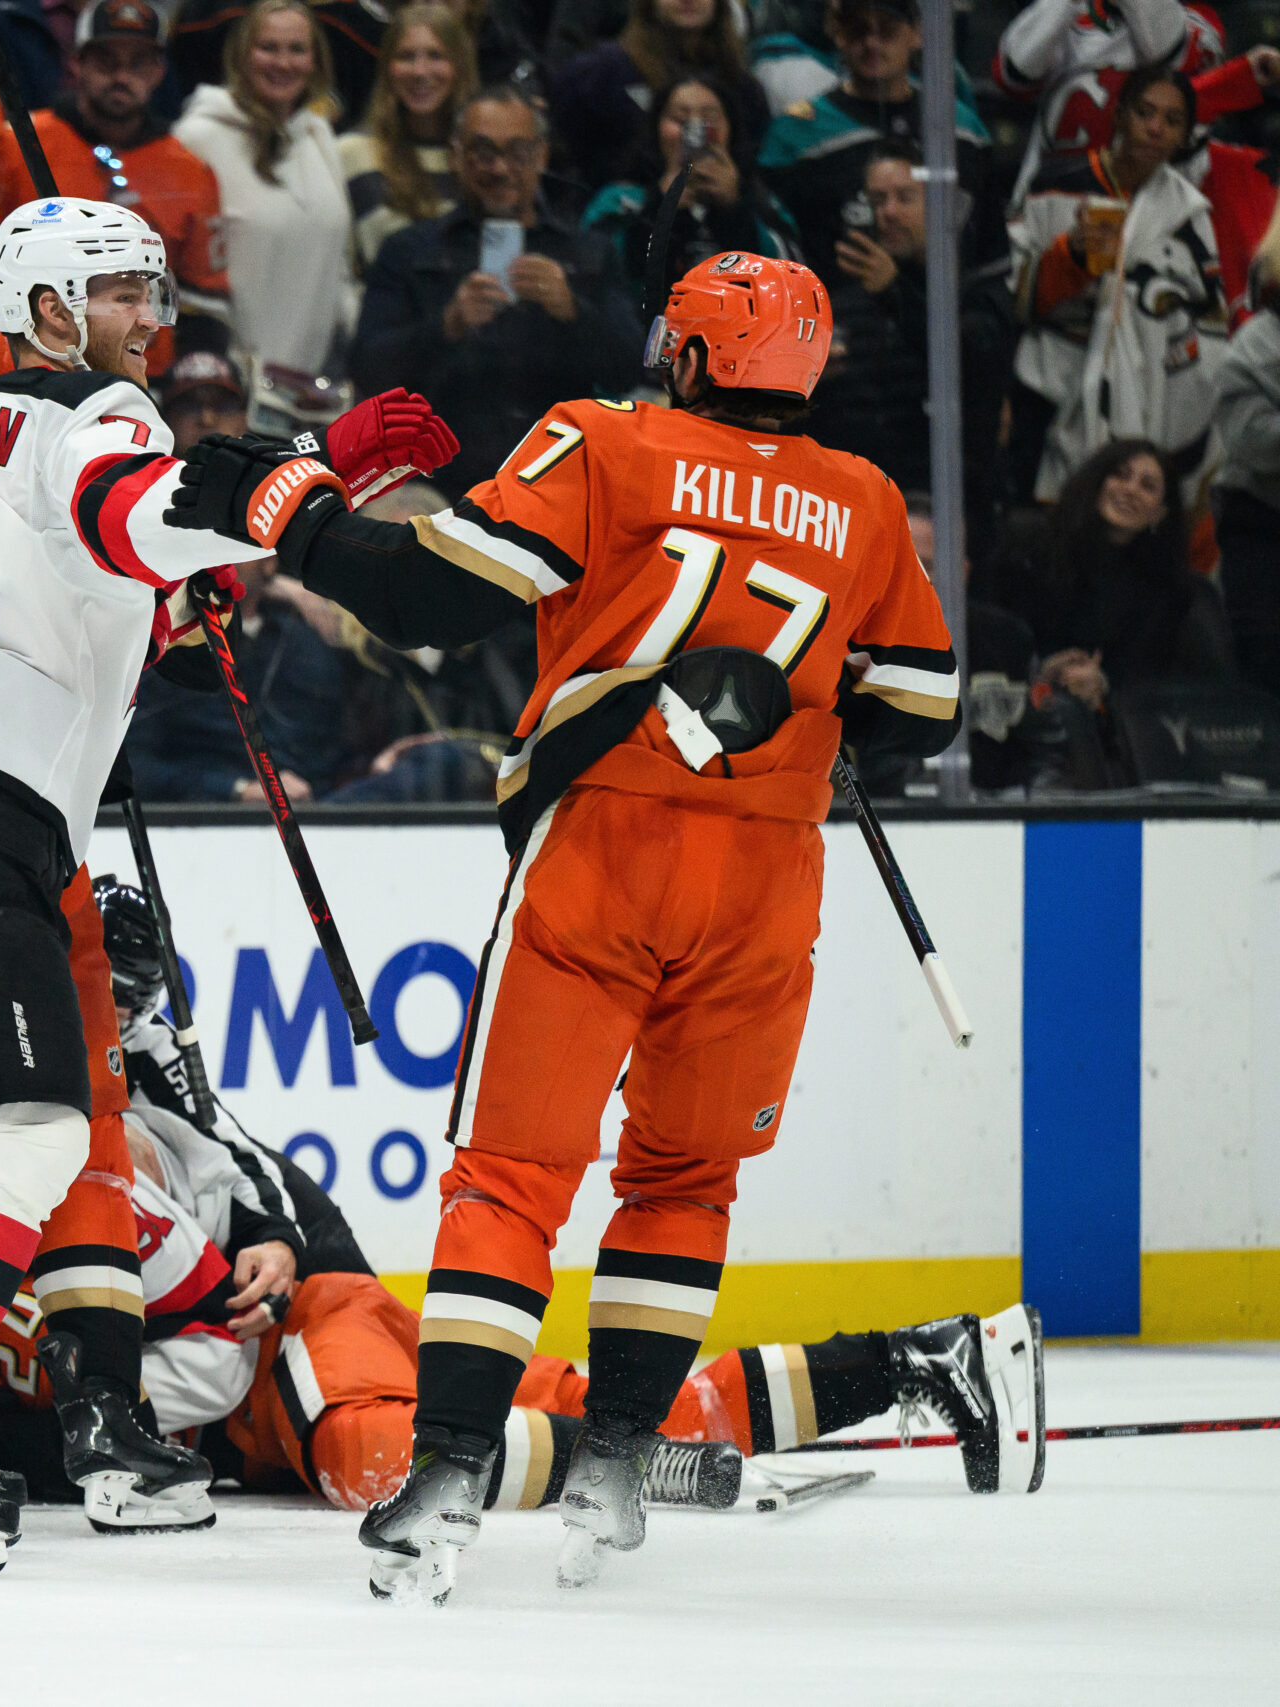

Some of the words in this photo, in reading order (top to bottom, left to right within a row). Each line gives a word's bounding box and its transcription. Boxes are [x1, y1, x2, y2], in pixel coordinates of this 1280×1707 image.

[797, 317, 817, 342] 17
[349, 466, 380, 491] HAMILTON
[671, 459, 852, 560] KILLORN
[11, 1000, 36, 1069] BAUER
